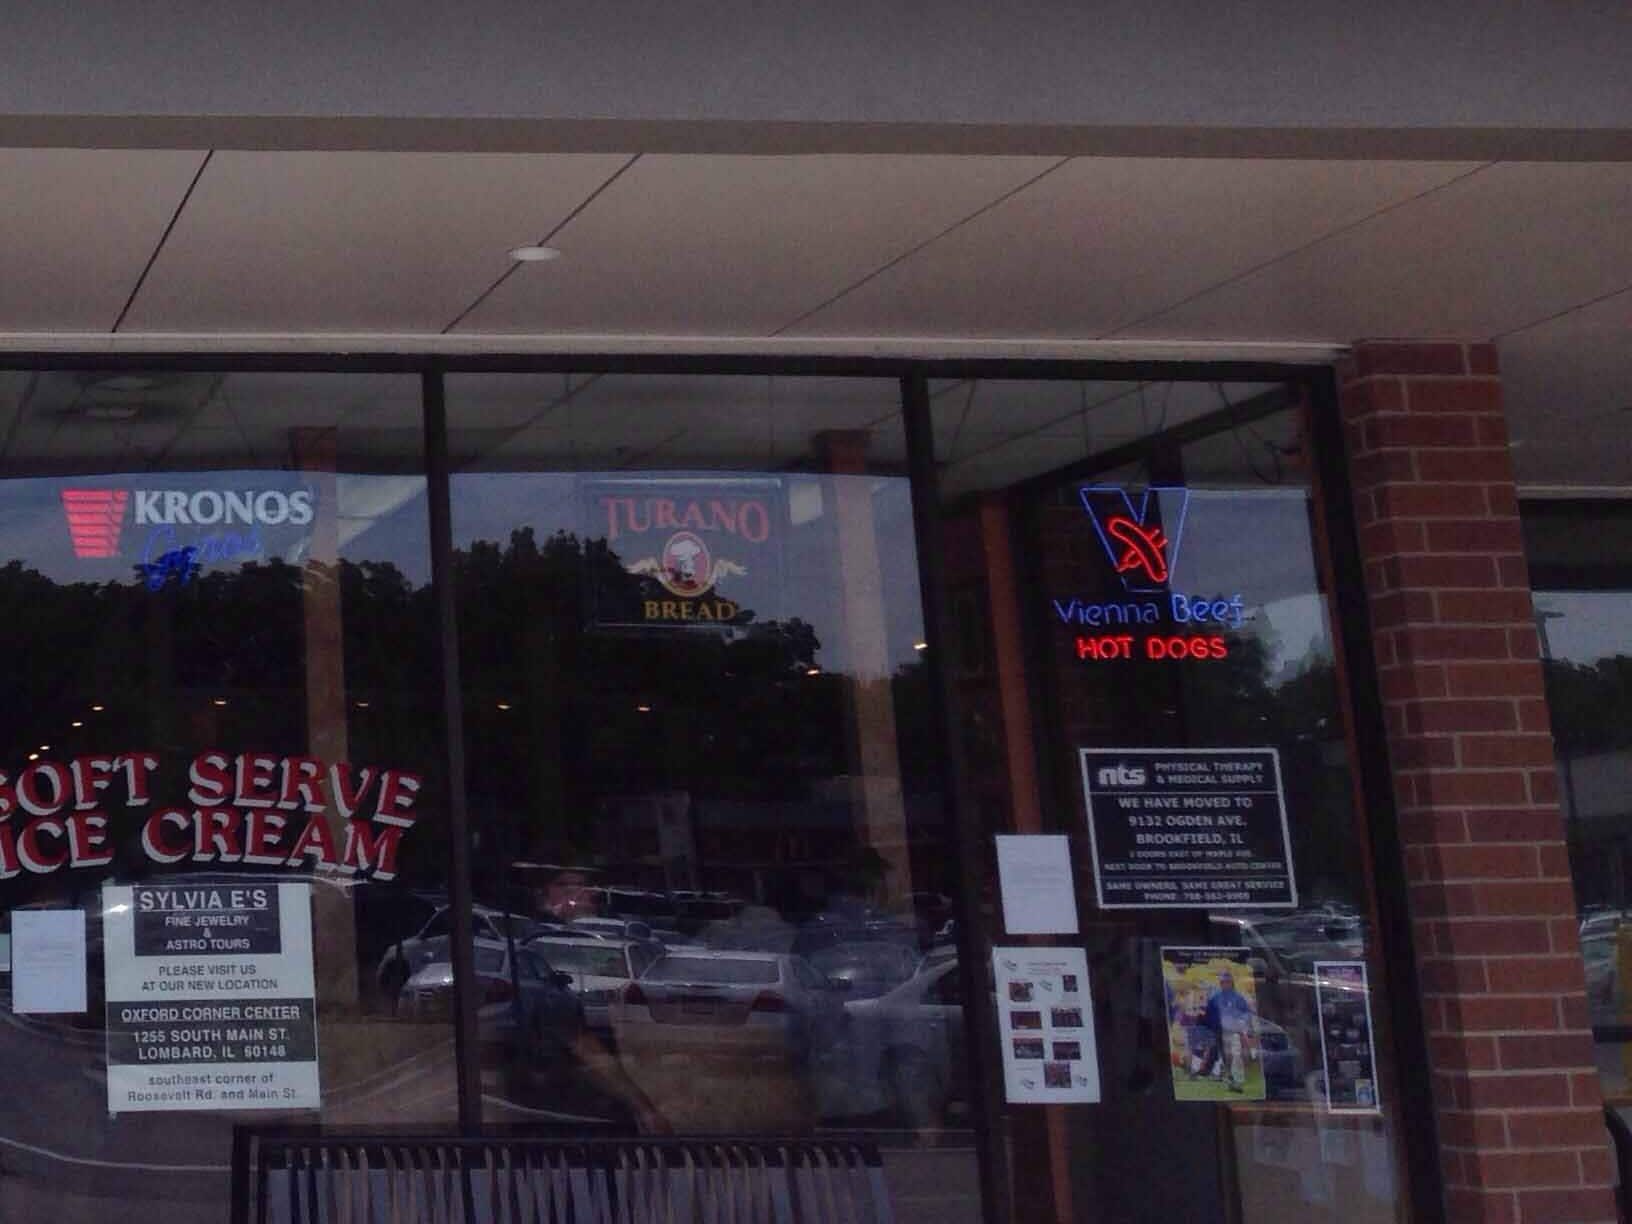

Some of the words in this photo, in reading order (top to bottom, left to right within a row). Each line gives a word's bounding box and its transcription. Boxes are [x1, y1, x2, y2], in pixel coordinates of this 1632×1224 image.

[134, 490, 315, 526] KRONOS
[600, 496, 769, 543] TURANO
[643, 600, 737, 621] BREAD
[1053, 599, 1161, 626] Vienna
[1170, 593, 1244, 628] Beef
[1075, 634, 1136, 661] HOT
[1144, 634, 1228, 661] DOGS
[1098, 761, 1147, 786] nts
[1154, 762, 1210, 773] PHYSICAL
[1214, 762, 1264, 773] THERAPY
[1168, 774, 1218, 785] MEDICAL
[1220, 774, 1264, 785] SUPPLY
[187, 748, 424, 829] SERVE
[1118, 797, 1140, 808] WE
[1143, 797, 1180, 809] HAVE
[1183, 797, 1231, 809] MOVED
[1234, 797, 1253, 808] TO
[1128, 815, 1162, 826] 9132
[1165, 815, 1213, 827] OGDEN
[1218, 815, 1248, 827] AVE.
[140, 805, 404, 881] CREAM
[1136, 833, 1226, 845] BROOKFIELD,
[1229, 833, 1244, 844] IL
[139, 891, 223, 910] SYLVIA
[231, 889, 268, 908] E'S
[165, 916, 191, 927] FINE
[194, 915, 250, 927] JEWELRY
[203, 927, 212, 938] &
[166, 939, 207, 951] ASTRO
[210, 938, 250, 950] TOURS
[158, 965, 207, 977] PLEASE
[208, 965, 238, 976] VISIT
[240, 964, 256, 975] US
[141, 981, 155, 992] AT
[159, 980, 184, 991] OUR
[188, 980, 215, 991] NEW
[218, 978, 278, 990] LOCATION
[121, 1008, 178, 1022] OXFORD
[182, 1007, 240, 1020] CORNER
[244, 1005, 301, 1019] CENTER
[133, 1031, 166, 1043] 1255
[170, 1030, 221, 1042] SOUTH
[226, 1029, 265, 1041] MAIN
[268, 1028, 291, 1040] ST.
[138, 1047, 217, 1060] LOMBARD,
[222, 1046, 234, 1058] IL
[148, 1074, 212, 1086] southeast
[215, 1075, 256, 1085] corner
[261, 1073, 274, 1083] of
[128, 1090, 190, 1102] Roosevelt
[221, 1088, 244, 1099] and
[248, 1088, 278, 1099] Main
